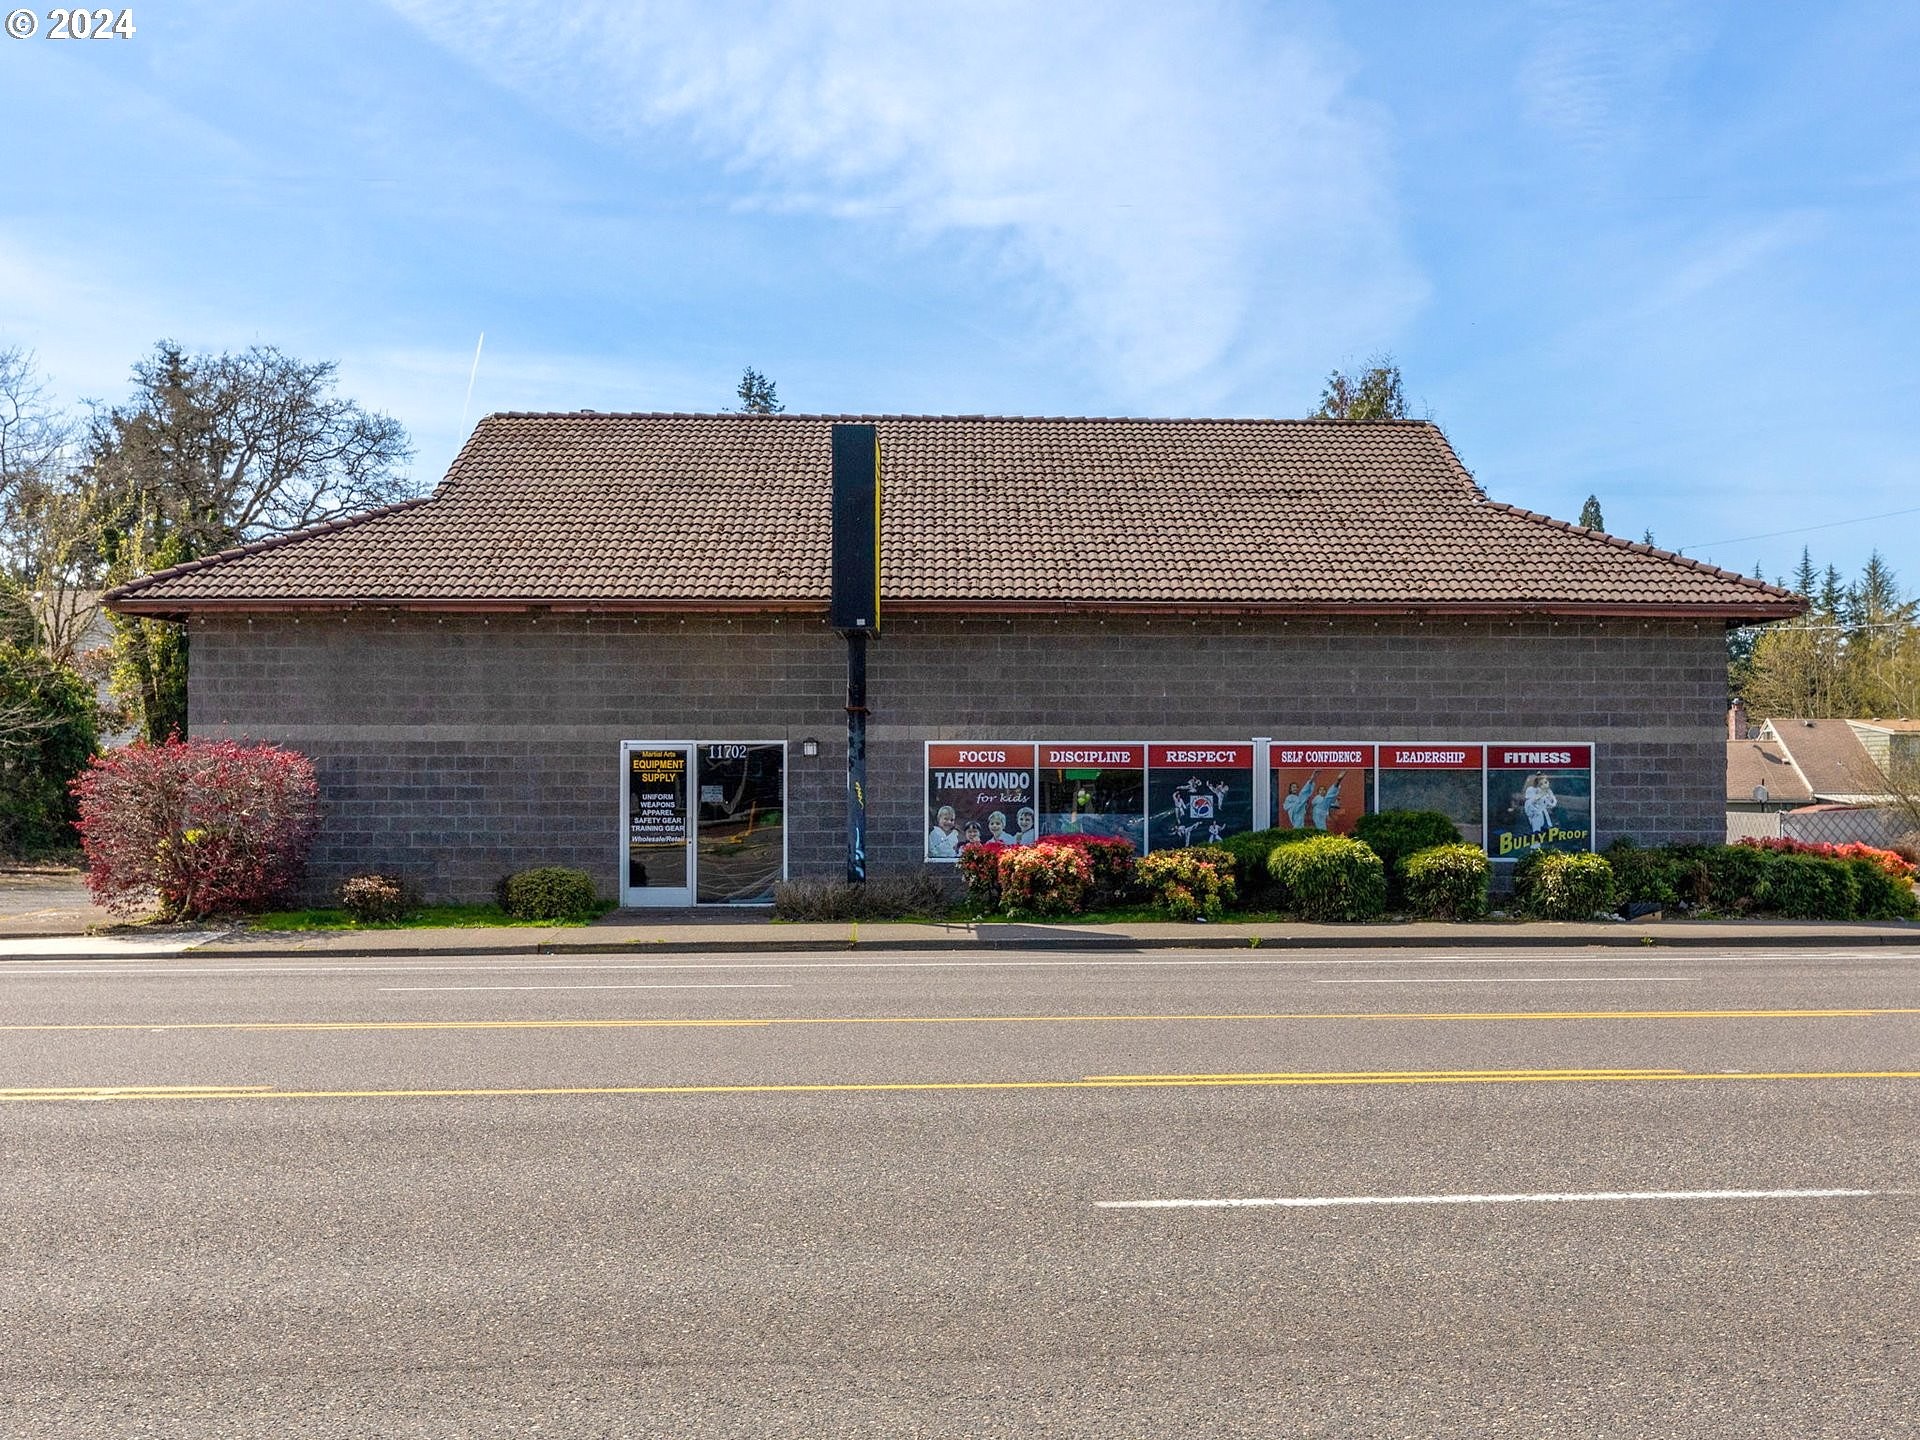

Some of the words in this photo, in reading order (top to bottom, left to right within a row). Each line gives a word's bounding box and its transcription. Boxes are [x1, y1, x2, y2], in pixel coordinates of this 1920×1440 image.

[709, 745, 747, 759] 11702
[959, 751, 1006, 763] FOCUS
[1050, 751, 1131, 763] DISCIPLINE
[1166, 751, 1236, 763] RESPECT
[1281, 751, 1303, 763] SELF
[1306, 751, 1362, 763] CONFIDENCE
[1395, 751, 1466, 764] LEADERSHIP
[1504, 752, 1571, 764] FITNESS
[633, 760, 684, 769] EQUIPMENT
[641, 773, 676, 782] SUPPLY
[934, 772, 1030, 789] TAEKWONDO
[976, 792, 997, 804] for
[1000, 792, 1030, 803] kids
